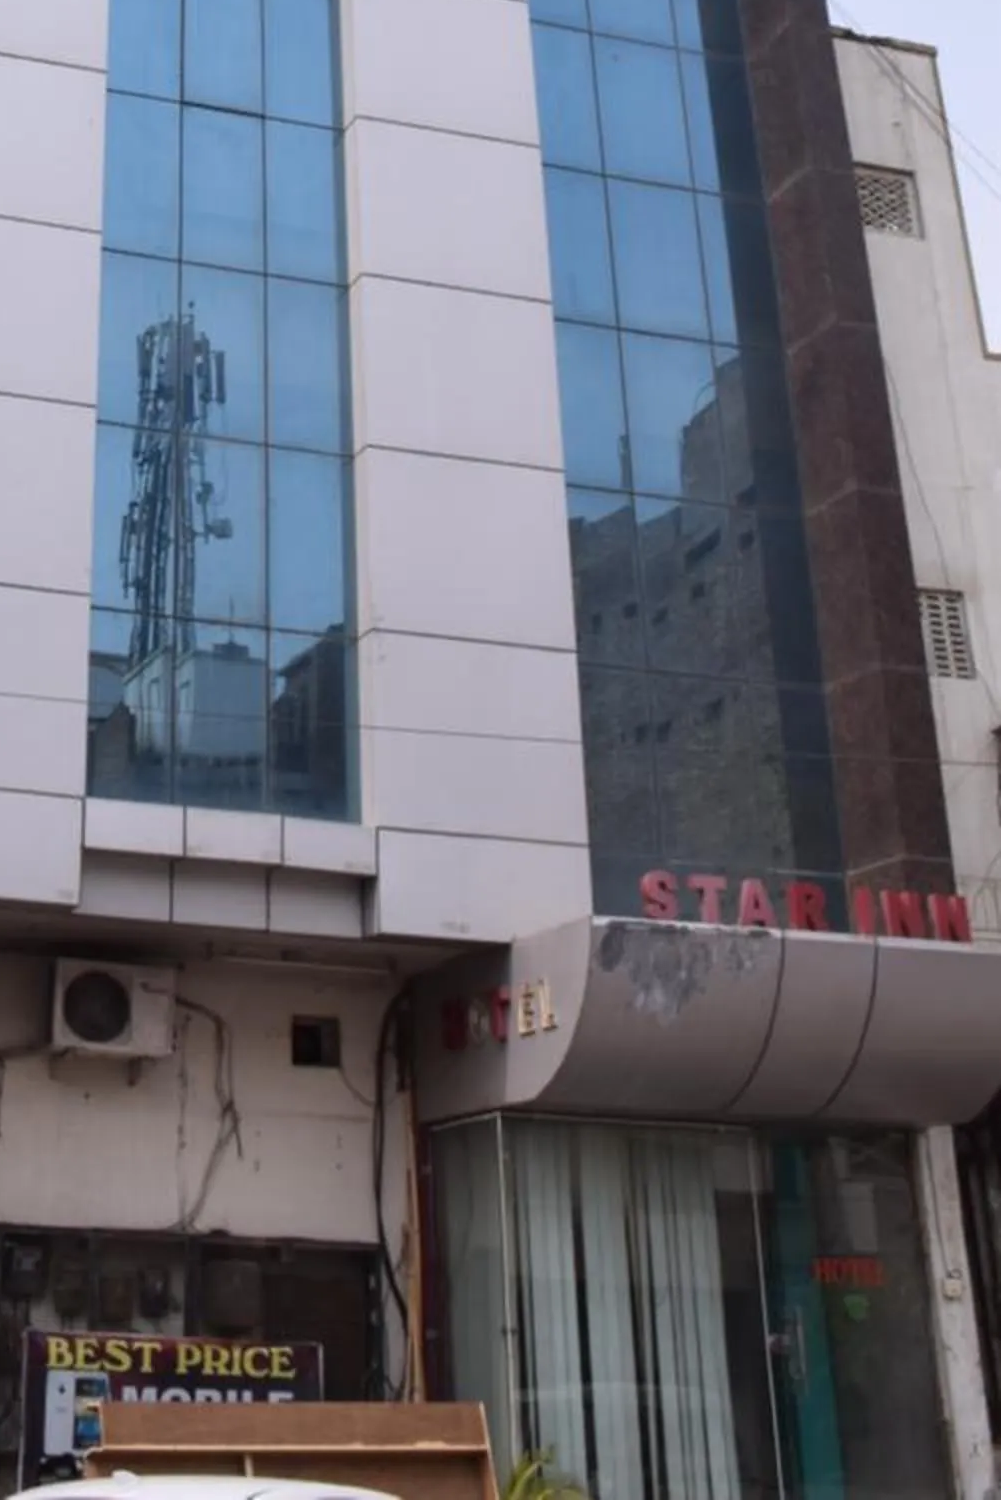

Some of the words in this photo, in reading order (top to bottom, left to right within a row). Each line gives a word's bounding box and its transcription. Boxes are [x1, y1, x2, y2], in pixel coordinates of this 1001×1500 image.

[639, 869, 830, 933] STAR
[854, 886, 973, 943] INN
[46, 1336, 162, 1374] BEST
[175, 1343, 297, 1380] PRICE
